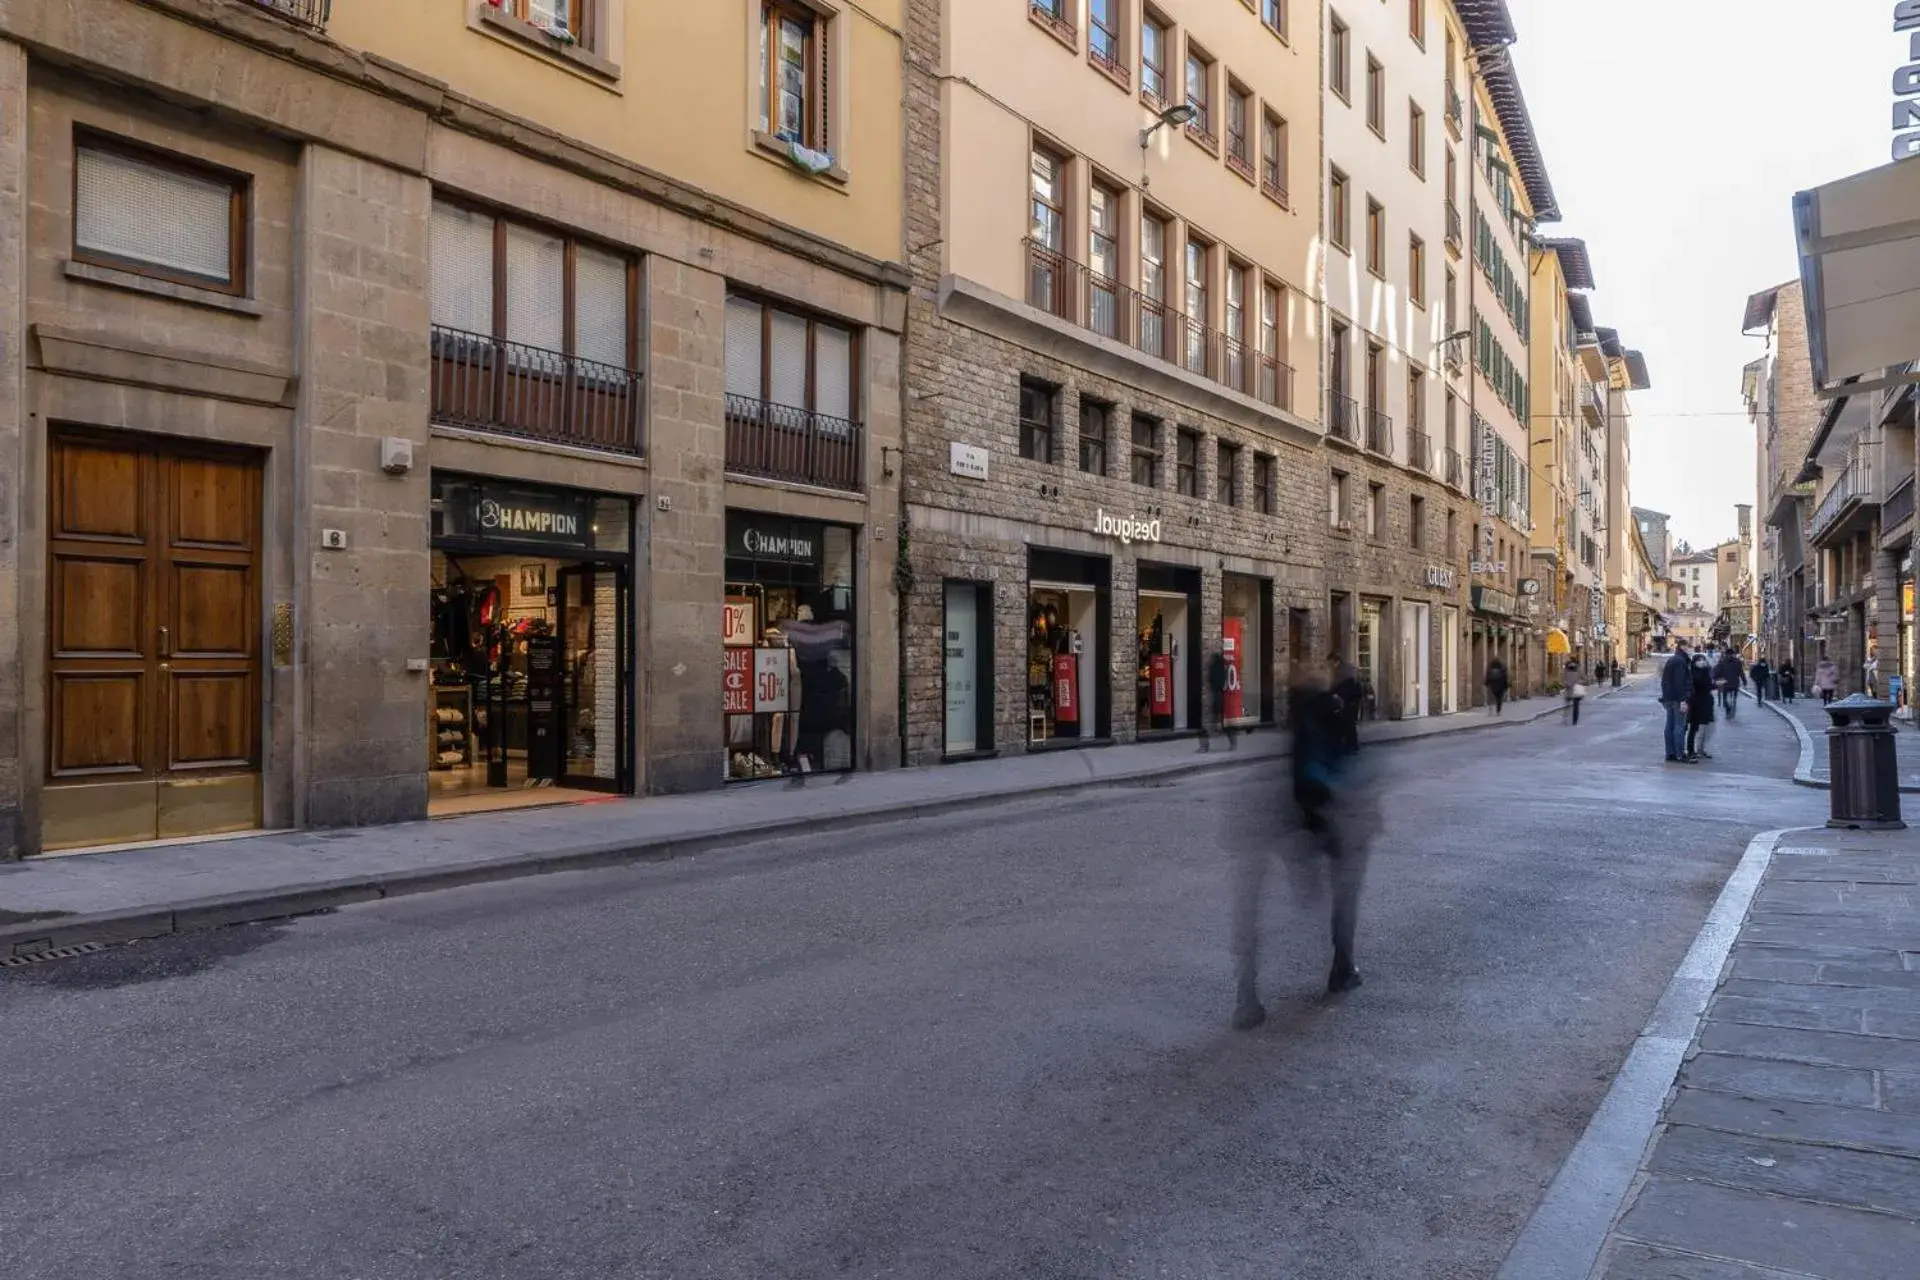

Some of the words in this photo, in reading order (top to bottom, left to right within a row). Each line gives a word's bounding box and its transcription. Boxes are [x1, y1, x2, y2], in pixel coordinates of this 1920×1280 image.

[1428, 565, 1453, 588] GUESS
[1470, 562, 1507, 573] BAR
[724, 650, 748, 670] SALE
[758, 672, 785, 702] 50%
[724, 690, 748, 710] SALE
